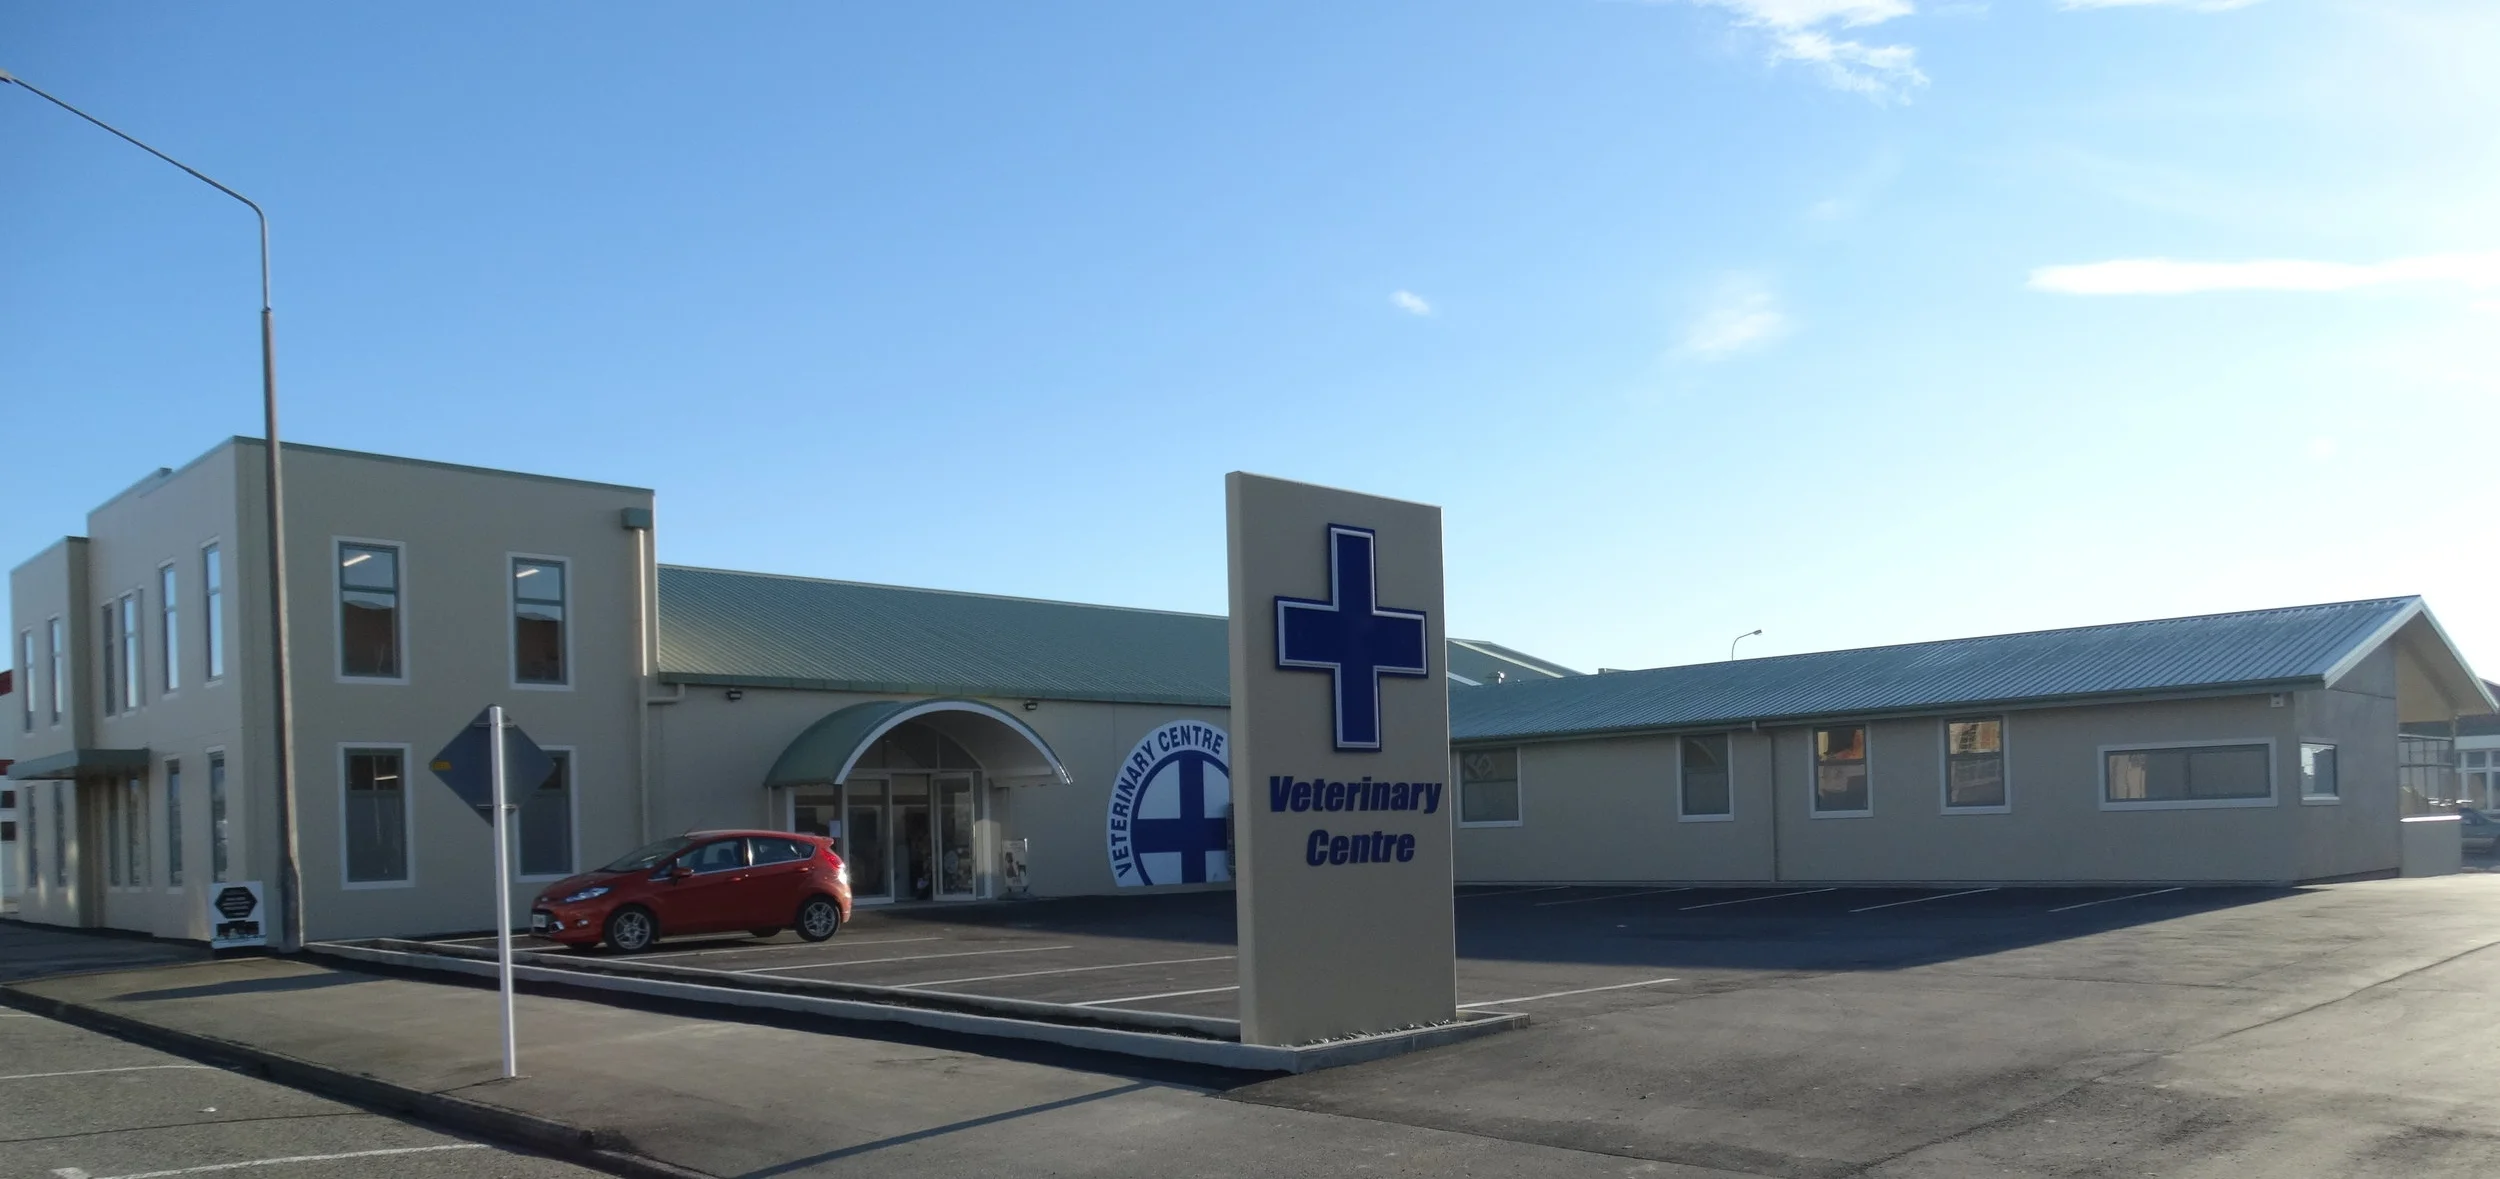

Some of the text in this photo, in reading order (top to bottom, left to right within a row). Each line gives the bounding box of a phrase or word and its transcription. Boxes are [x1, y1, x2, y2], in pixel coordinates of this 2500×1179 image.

[1111, 725, 1224, 878] VETERINARY CENTRE
[1270, 776, 1442, 814] Veterinary
[1306, 829, 1415, 867] Centre
